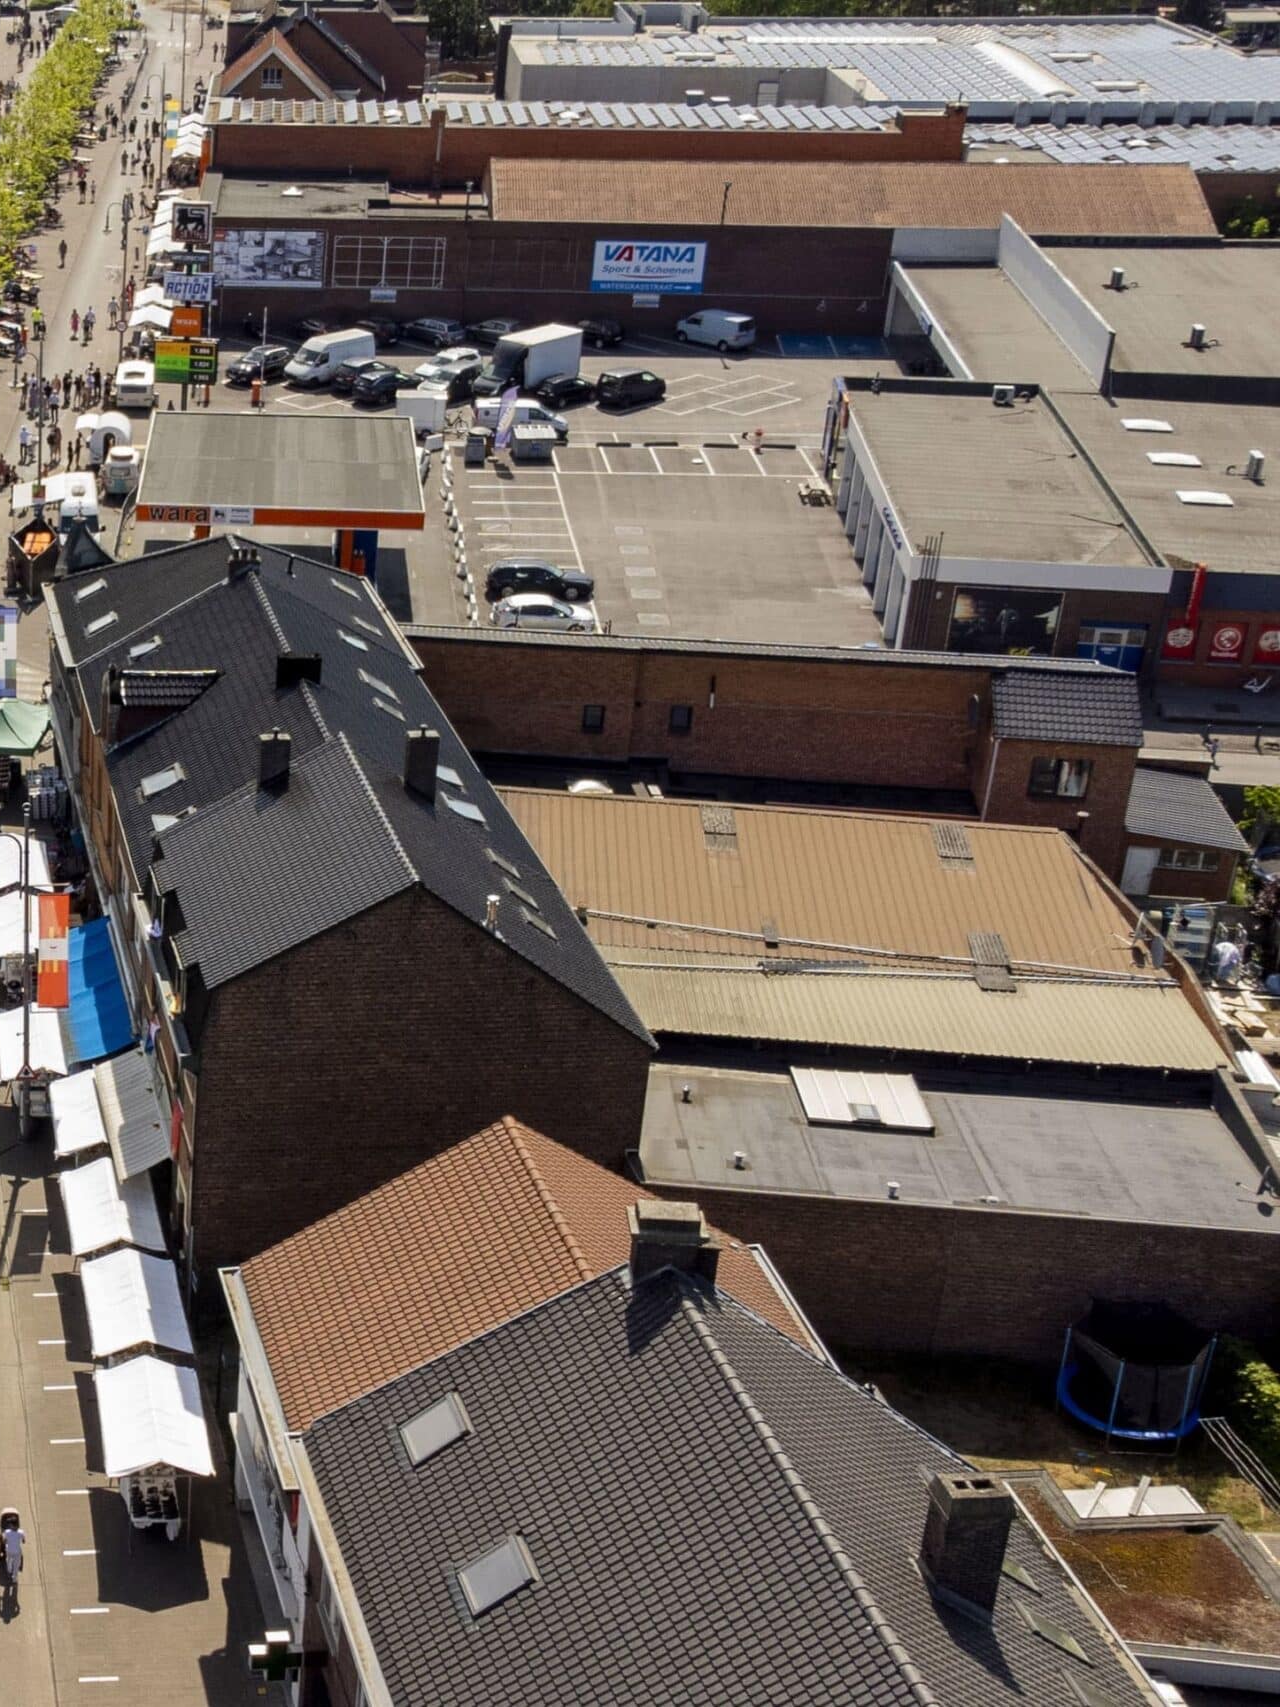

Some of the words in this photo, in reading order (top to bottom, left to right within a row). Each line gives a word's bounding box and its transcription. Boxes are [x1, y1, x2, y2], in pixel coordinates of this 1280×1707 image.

[604, 245, 696, 262] VATANA
[600, 264, 629, 274] Sport
[633, 265, 640, 273] &
[645, 265, 694, 274] Schoenen
[166, 282, 209, 295] ACTION
[150, 505, 208, 521] wara
